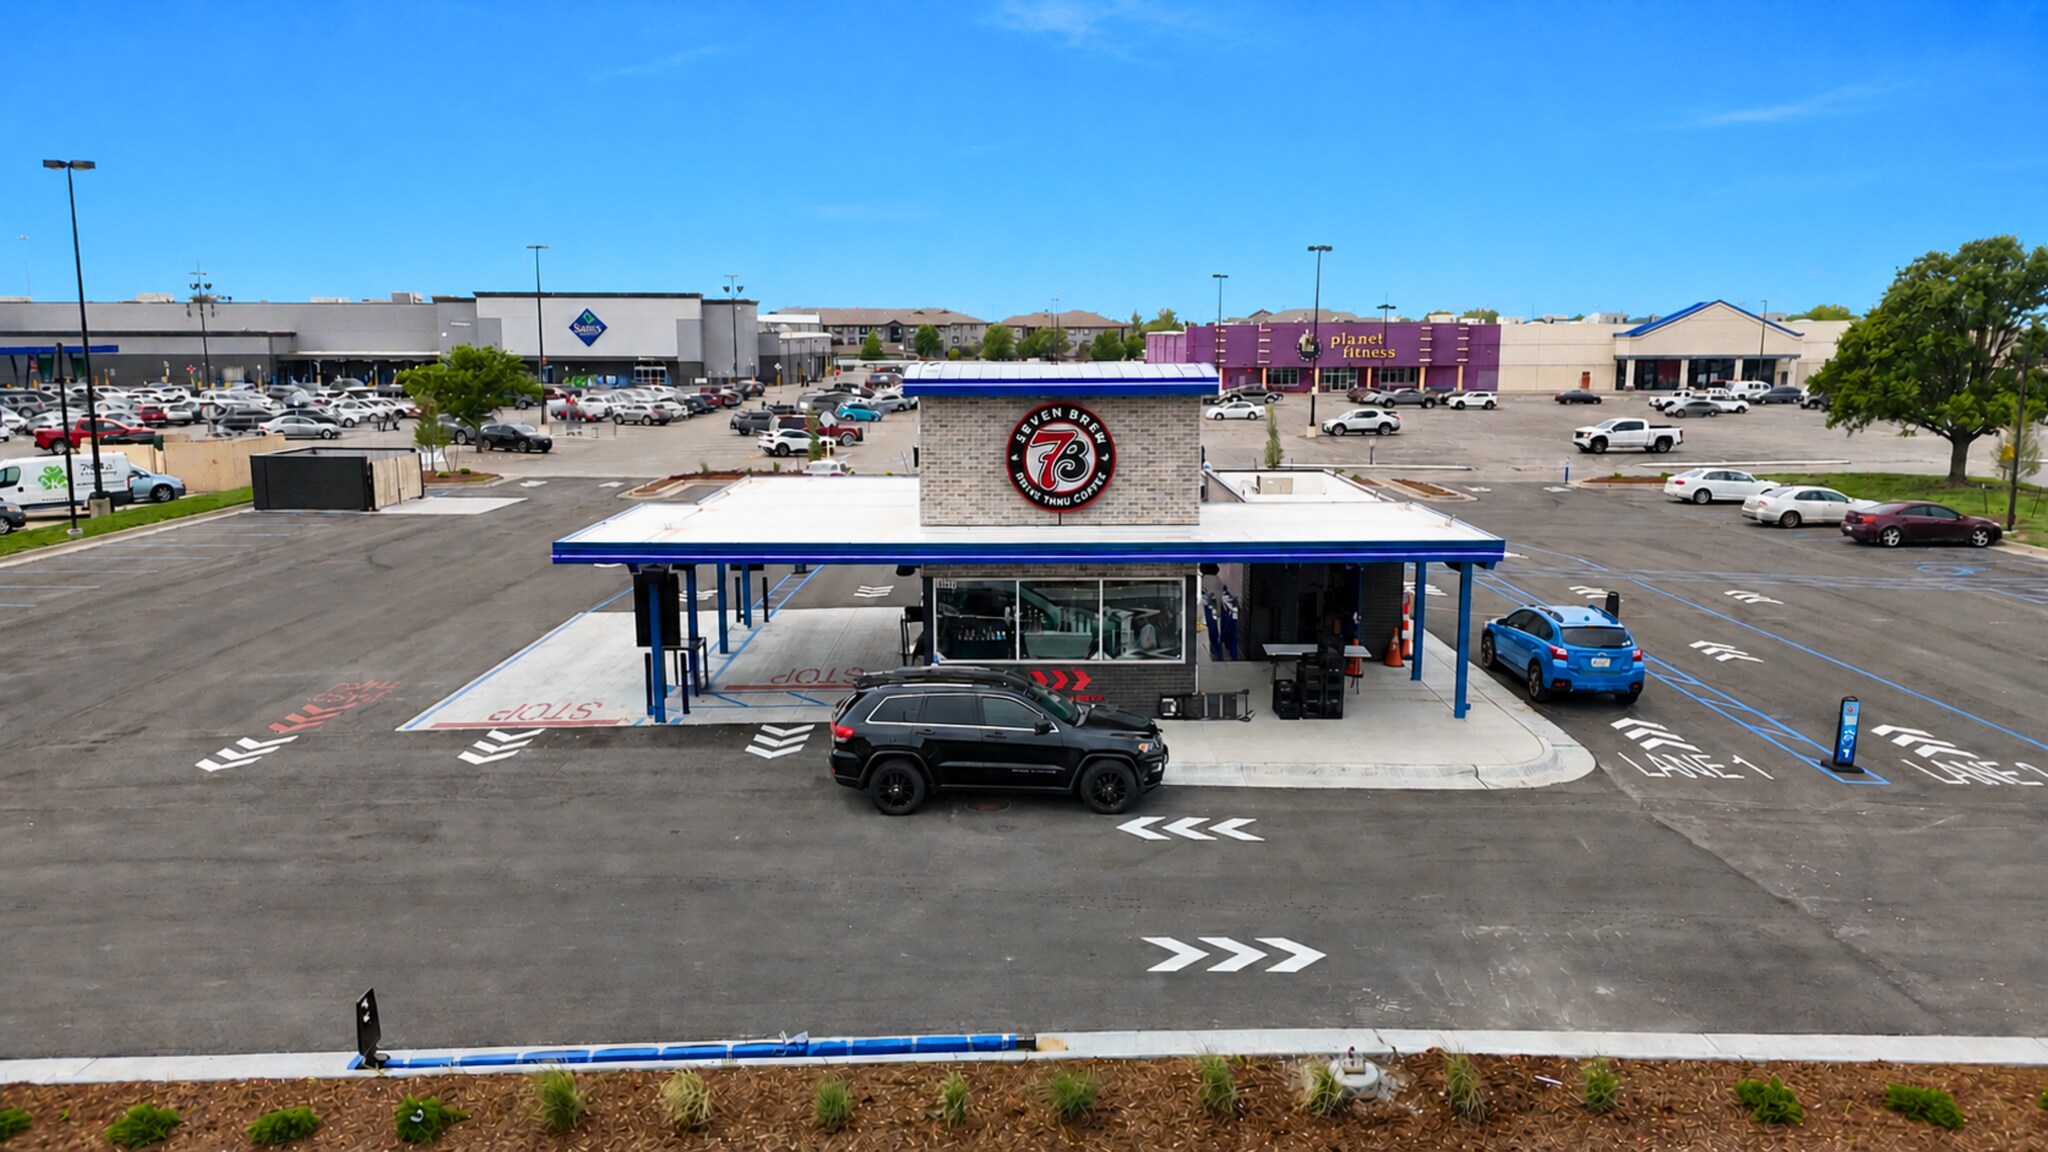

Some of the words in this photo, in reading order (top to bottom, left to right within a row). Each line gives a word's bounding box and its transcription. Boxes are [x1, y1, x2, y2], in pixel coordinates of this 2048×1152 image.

[1330, 332, 1383, 348] planet
[1343, 345, 1396, 358] fitness
[1016, 407, 1062, 443] SEVEN
[1068, 409, 1106, 444] BREW
[1043, 495, 1071, 506] THRU
[1073, 472, 1107, 503] COFFEE
[770, 666, 865, 684] STOP
[488, 701, 603, 721] STOP
[1617, 752, 1745, 779] LANE
[1732, 754, 1774, 780] 1
[1901, 758, 2044, 786] LANE
